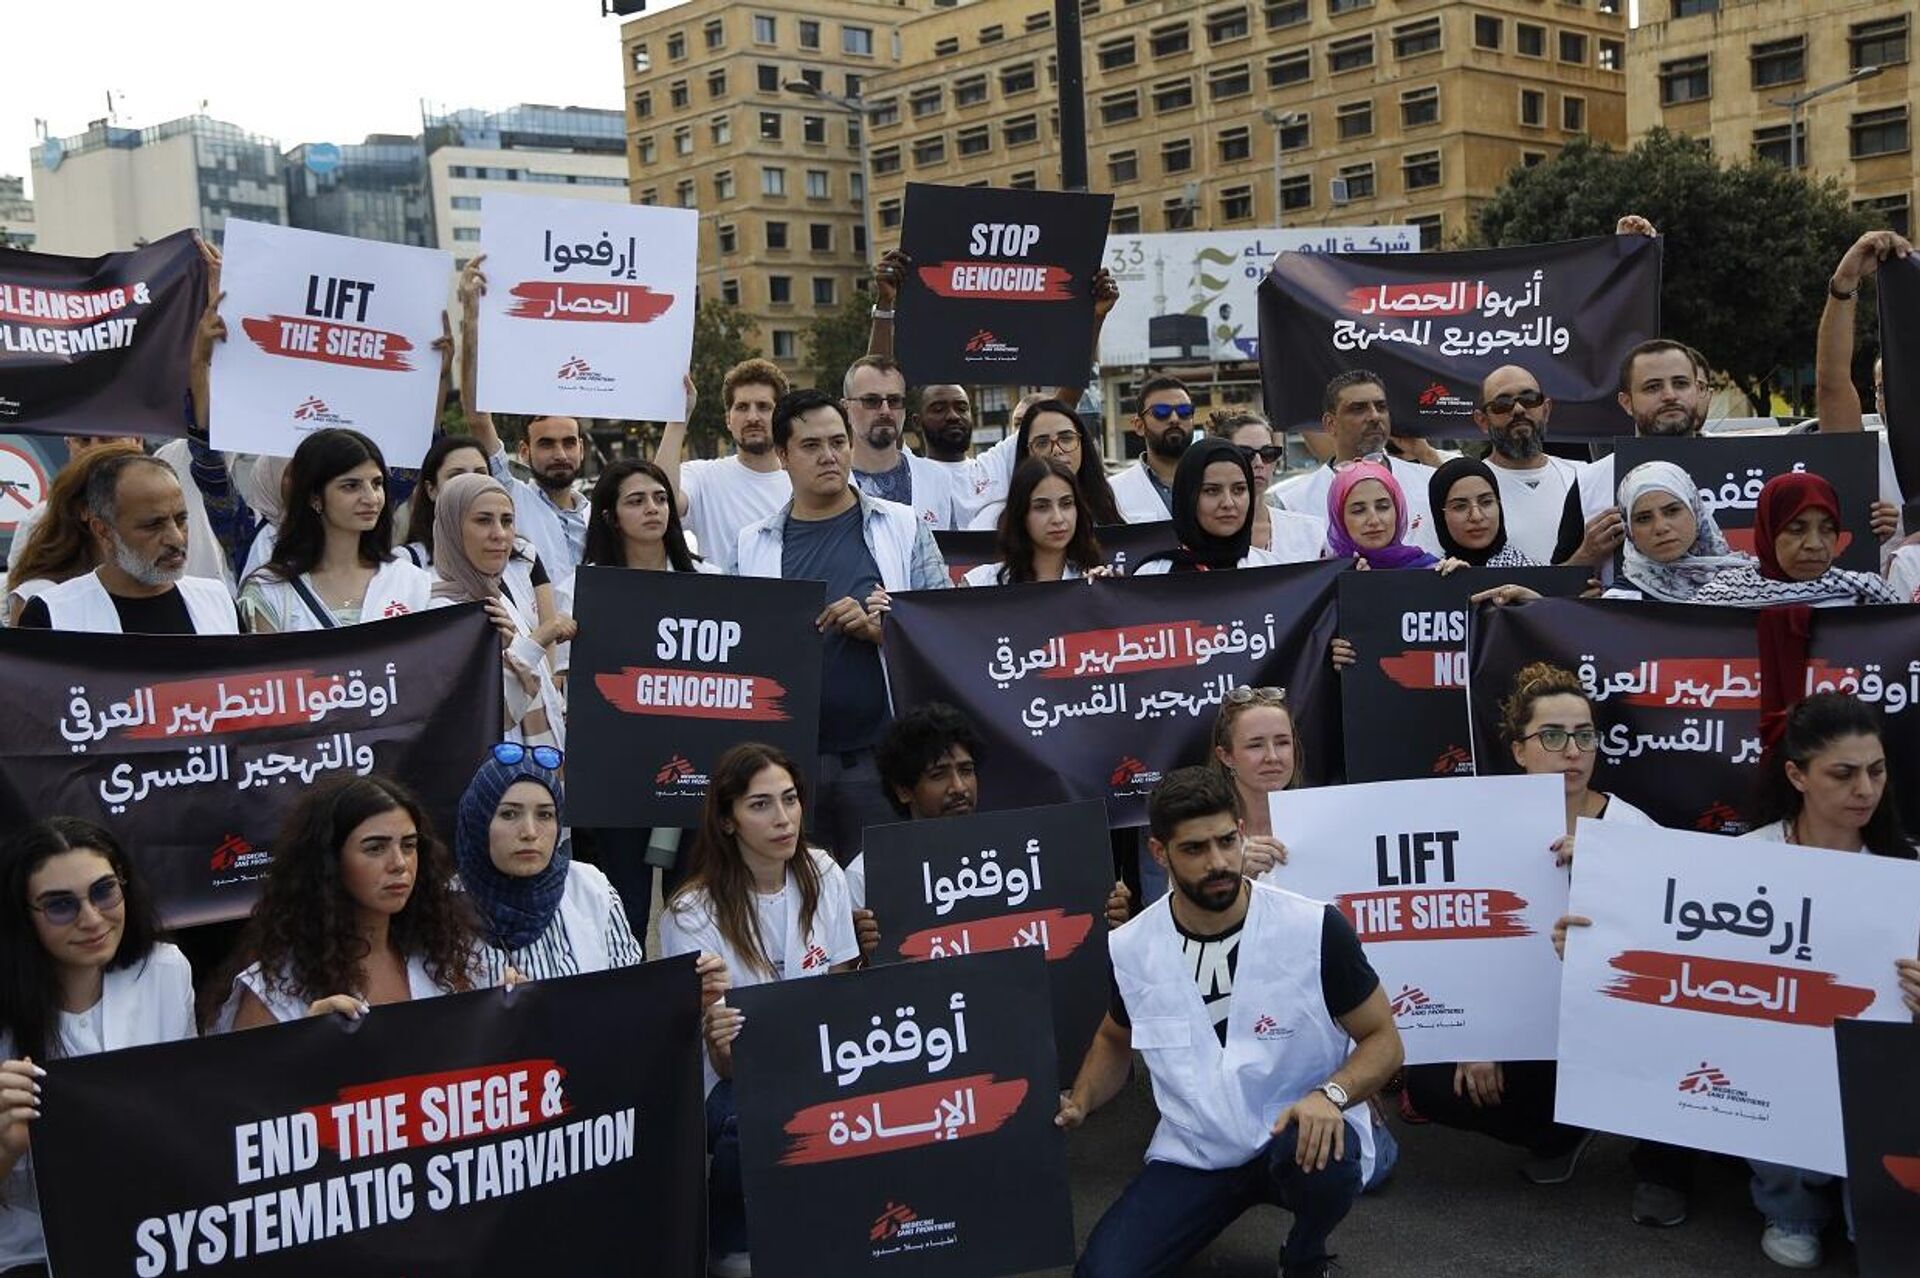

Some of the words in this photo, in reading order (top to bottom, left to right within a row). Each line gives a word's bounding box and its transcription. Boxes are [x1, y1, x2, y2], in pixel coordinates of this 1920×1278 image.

[543, 230, 637, 281] إرفعوا
[969, 223, 1041, 257] STOP
[0, 284, 126, 320] LEANSING
[132, 281, 152, 305] &
[305, 275, 375, 323] LIFT
[543, 289, 630, 318] الحصار
[951, 264, 1046, 293] GENOCIDE
[1362, 280, 1467, 315] الحصار
[1476, 269, 1544, 318] أنهوا
[0, 318, 138, 355] LACEMENT
[279, 321, 321, 354] THE
[325, 324, 388, 362] SIEGE
[1439, 316, 1571, 356] والتجويع
[656, 618, 742, 664] STOP
[1185, 613, 1276, 664] أوقفوا
[1402, 610, 1465, 643] CEAS
[987, 636, 1066, 690] العرقي
[1074, 629, 1176, 675] التطهير
[1434, 651, 1468, 687] NO
[165, 678, 287, 734] التطهير
[296, 662, 398, 722] أوقفوا
[636, 674, 754, 711] GENOCIDE
[1021, 683, 1127, 737] القسري
[59, 686, 156, 753] العرقي
[1600, 718, 1724, 765] القسري
[99, 744, 230, 814] القسري
[238, 733, 375, 790] والتهجير
[922, 838, 1042, 916] أوقفوا
[1376, 830, 1460, 887] LIFT
[1352, 896, 1402, 934] THE
[1411, 892, 1492, 932] SIEGE
[1663, 877, 1812, 961] إرفعوا
[1659, 962, 1798, 1013] الحصار
[818, 992, 968, 1087] أوقفوا
[235, 1110, 319, 1185] END
[331, 1092, 409, 1162] THE
[420, 1069, 531, 1144] SIEGE
[539, 1068, 564, 1118] &
[828, 1087, 976, 1146] الإبادة
[135, 1162, 415, 1278] SYSTEMATIC
[426, 1107, 636, 1210] STARVATION
